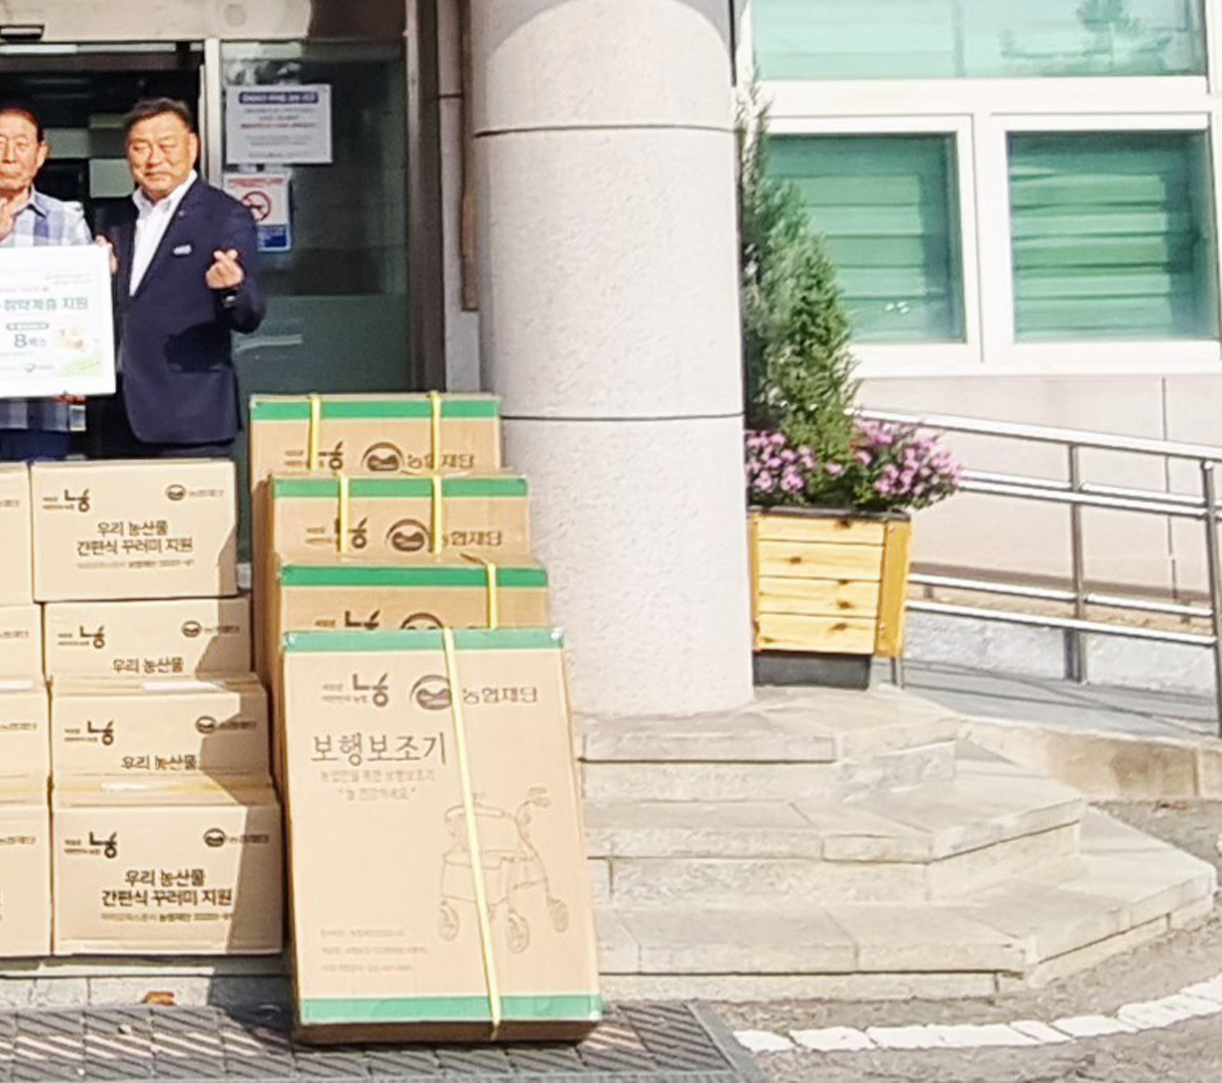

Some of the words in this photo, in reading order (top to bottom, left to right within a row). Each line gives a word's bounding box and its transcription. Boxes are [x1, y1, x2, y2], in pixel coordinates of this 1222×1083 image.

[61, 296, 90, 311] 지원
[97, 521, 124, 537] 우리
[128, 520, 169, 537] 농산물
[76, 540, 118, 556] 간편식
[121, 539, 163, 555] 꾸러미
[165, 537, 194, 553] 지원
[113, 658, 140, 673] 우리
[143, 657, 184, 674] 농산물
[352, 672, 390, 708] 농
[310, 731, 447, 767] 보행보조기
[154, 754, 197, 771] 농산물
[89, 830, 119, 859] 농
[124, 869, 156, 887] 우리
[159, 868, 206, 887] 농산물
[101, 889, 148, 907] 간편식
[152, 889, 199, 907] 꾸러미
[201, 888, 234, 906] 지원
